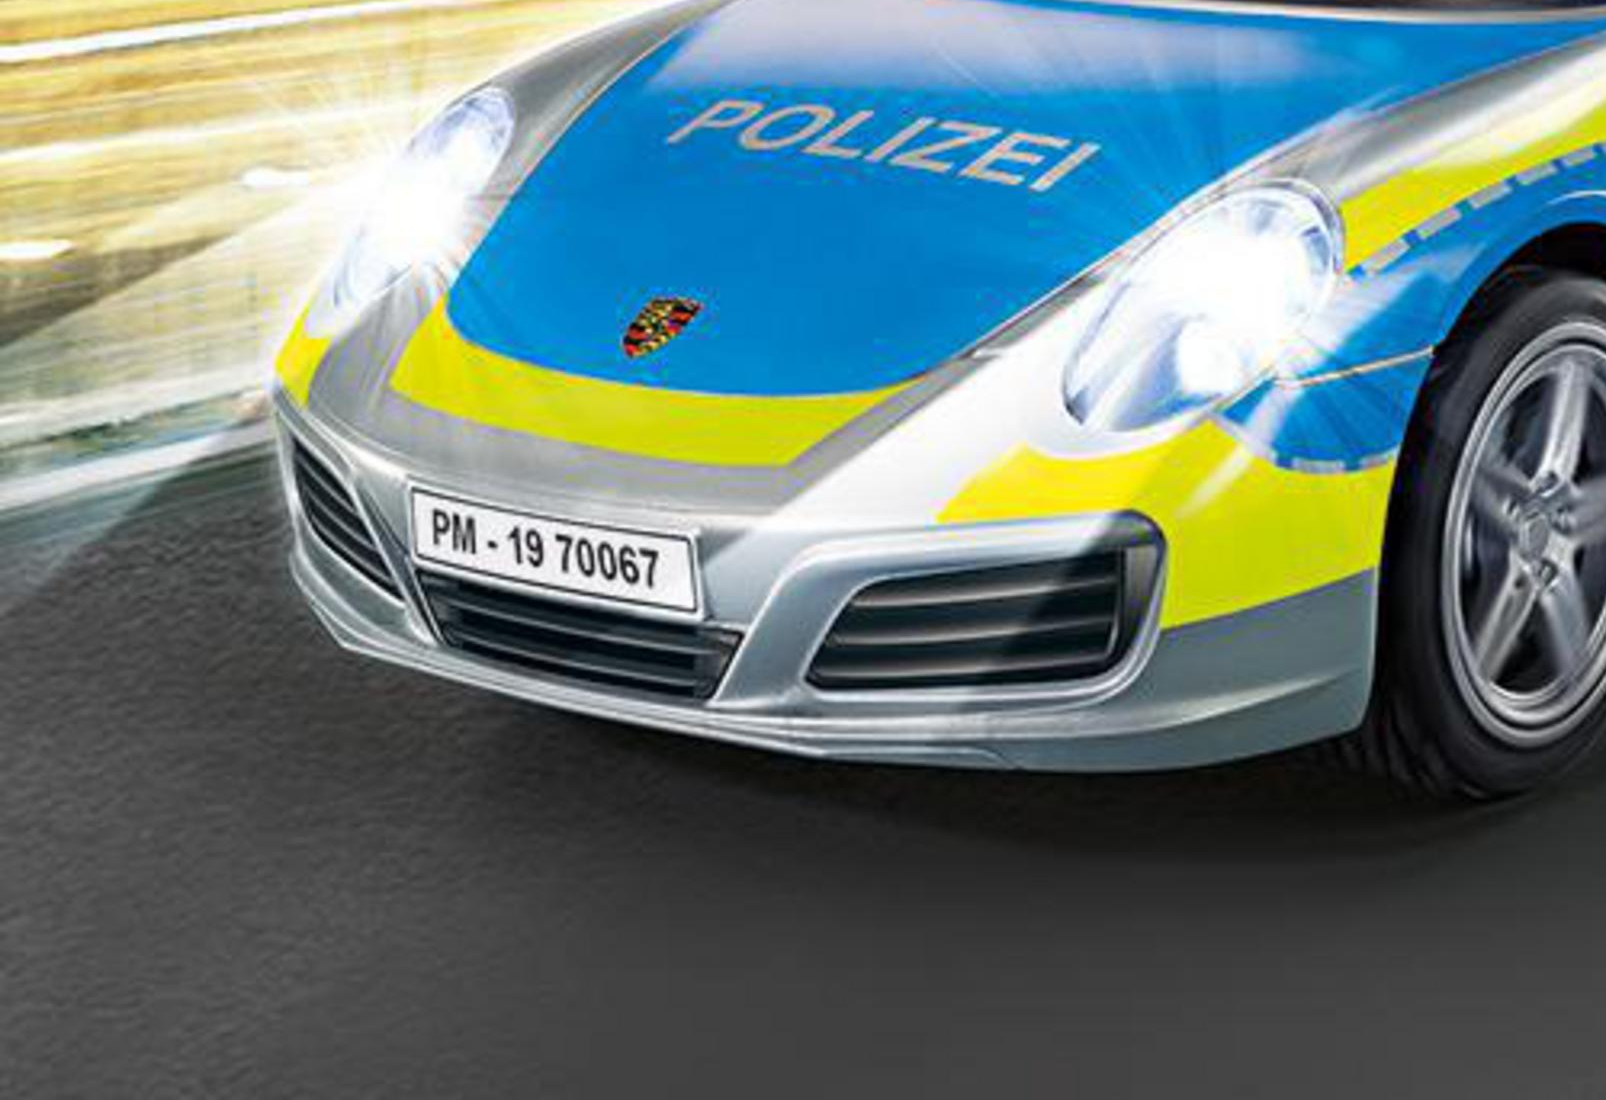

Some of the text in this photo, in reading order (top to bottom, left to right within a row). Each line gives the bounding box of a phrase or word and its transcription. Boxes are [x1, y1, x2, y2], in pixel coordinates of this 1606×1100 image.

[666, 98, 1101, 192] POLIZEI
[432, 509, 477, 555] PM
[507, 527, 544, 568] 19
[555, 533, 659, 587] 70067
